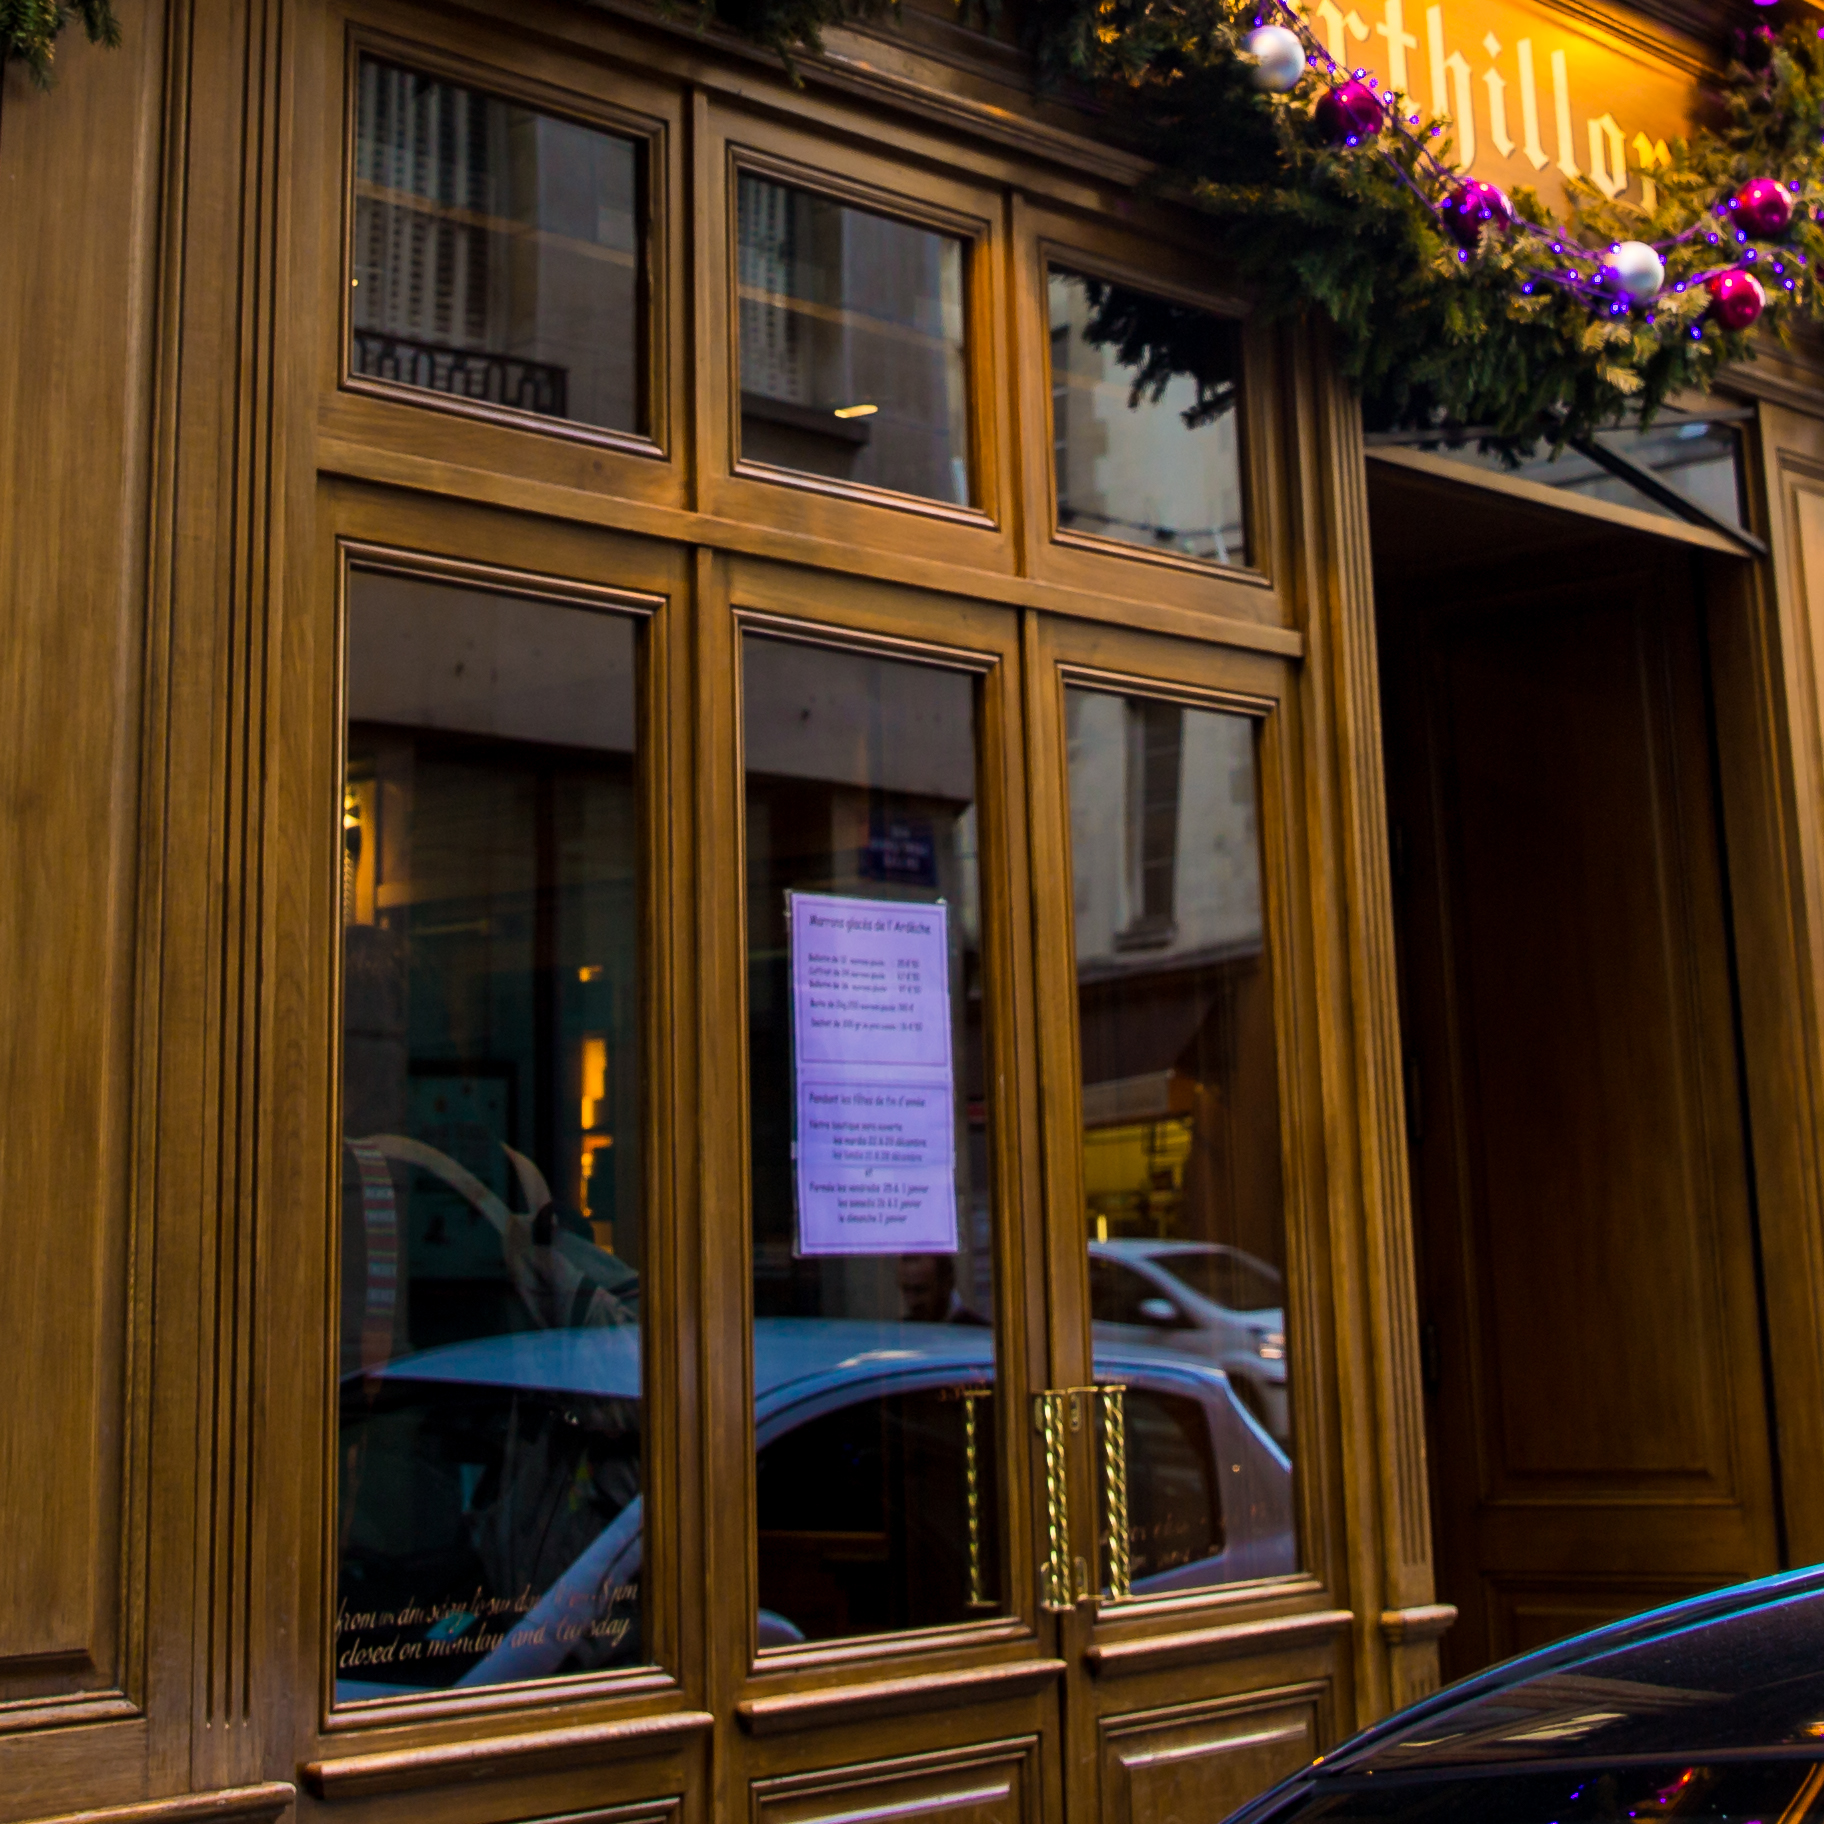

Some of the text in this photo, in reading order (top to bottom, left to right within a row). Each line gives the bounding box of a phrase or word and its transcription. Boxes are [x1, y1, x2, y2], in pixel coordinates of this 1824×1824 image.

[335, 1596, 376, 1643] from
[339, 1634, 400, 1669] closed
[398, 1641, 423, 1662] on
[511, 1618, 549, 1649] and
